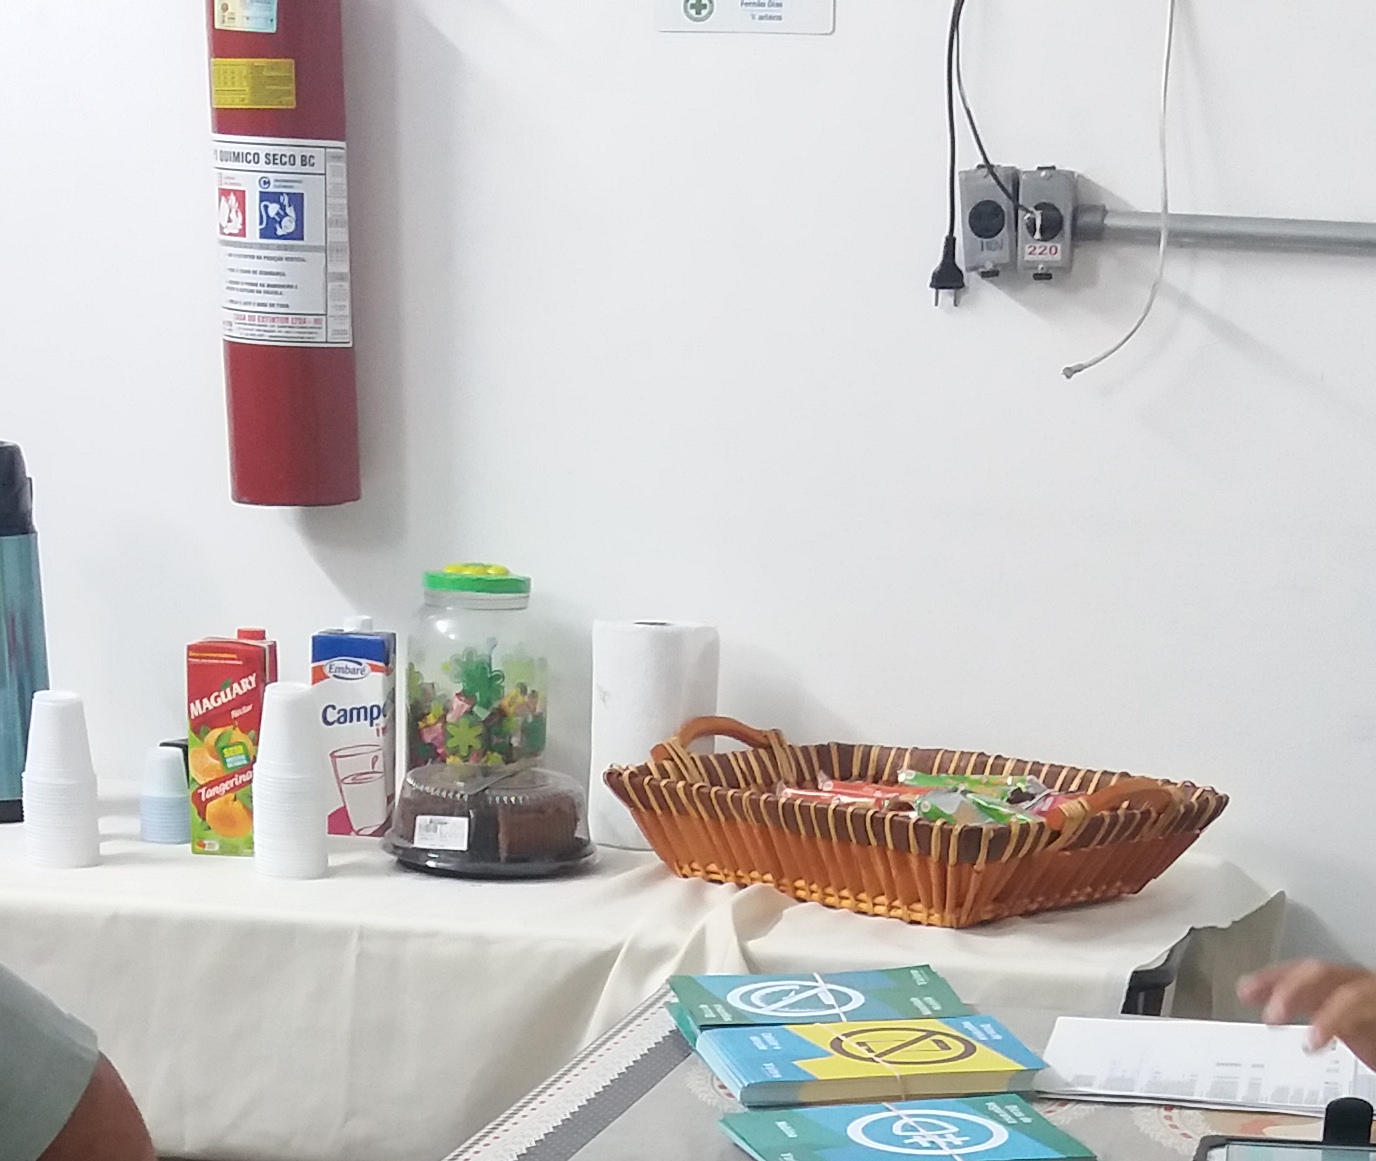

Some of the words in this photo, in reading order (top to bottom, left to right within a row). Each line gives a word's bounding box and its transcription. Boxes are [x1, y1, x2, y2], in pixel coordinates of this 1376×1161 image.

[264, 152, 297, 167] SECO
[300, 154, 316, 167] BC
[1027, 245, 1058, 257] 220
[328, 663, 366, 676] Embaré
[189, 673, 257, 719] MAGUARY
